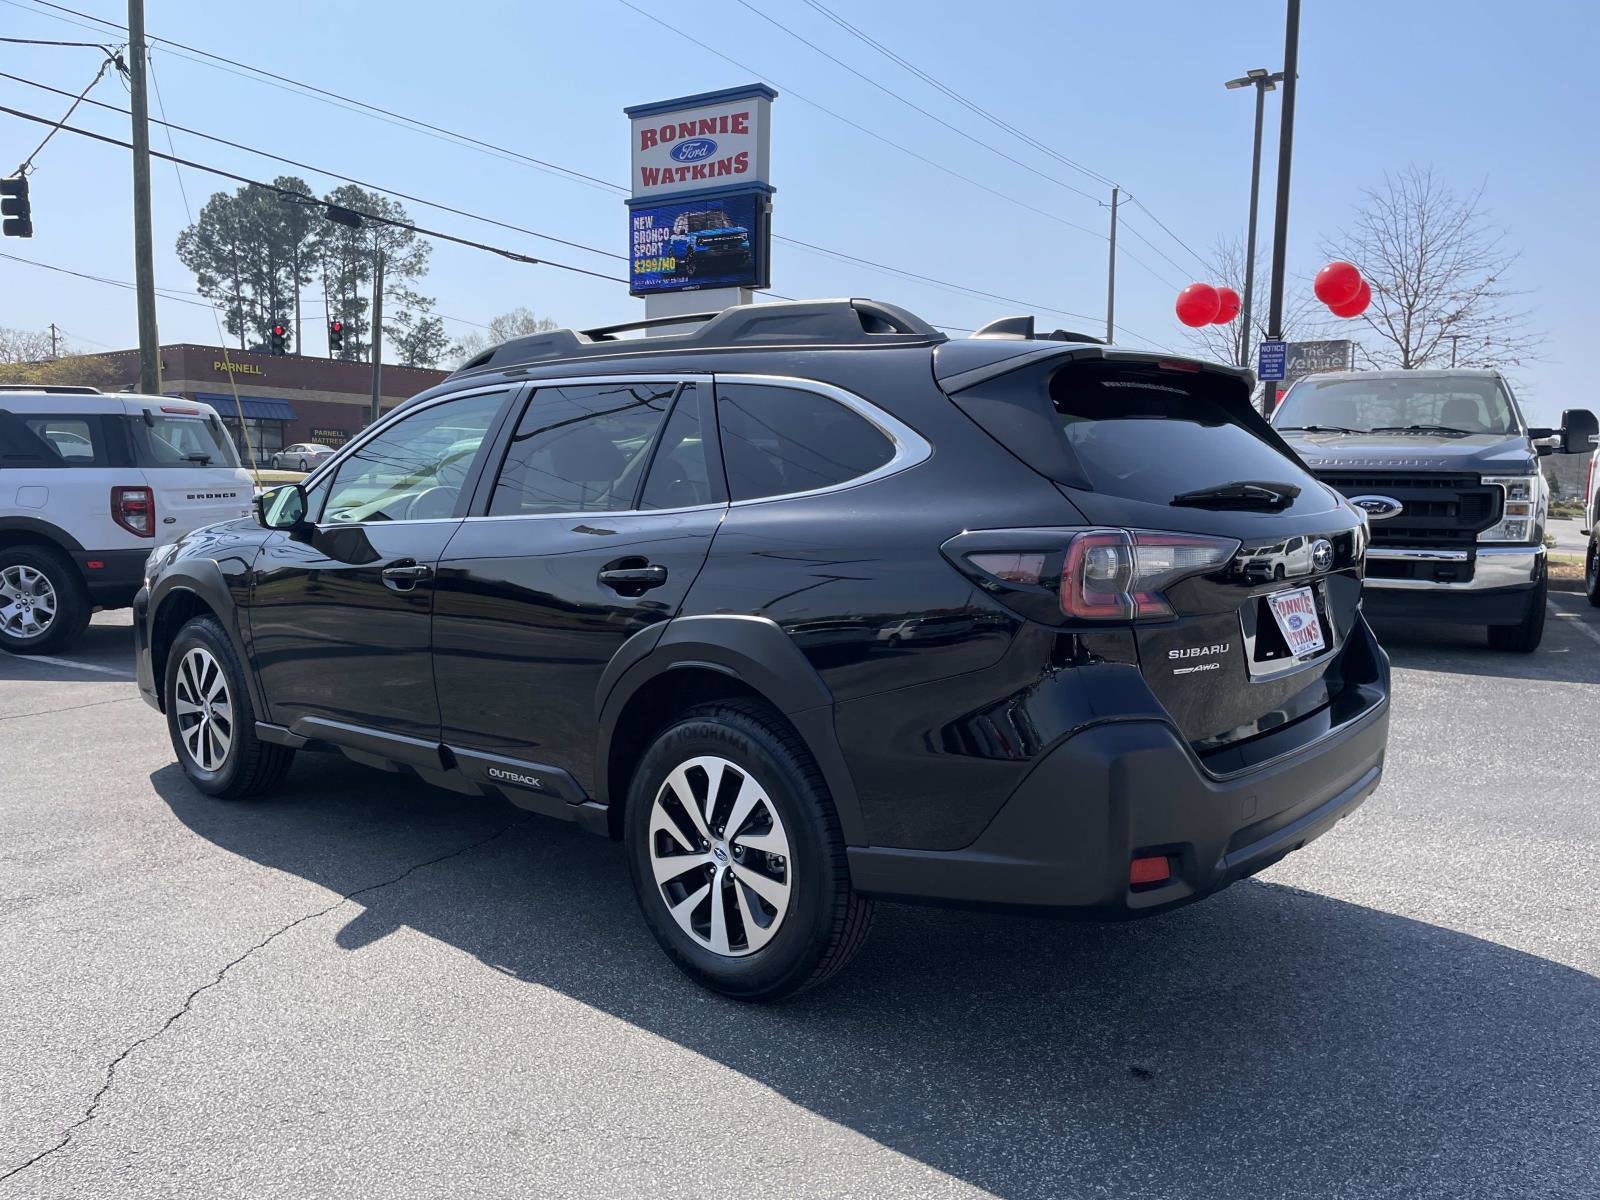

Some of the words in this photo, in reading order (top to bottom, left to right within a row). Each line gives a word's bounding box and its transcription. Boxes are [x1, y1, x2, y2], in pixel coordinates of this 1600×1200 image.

[640, 111, 750, 152] RONNIE
[679, 142, 708, 160] Ford
[640, 151, 749, 187] WATKINS
[633, 215, 653, 231] NEW
[633, 227, 670, 244] BRONCO
[633, 242, 664, 257] SPORT
[1261, 345, 1284, 353] NOTICE
[1301, 347, 1324, 357] The
[213, 360, 263, 375] PARNELL
[311, 437, 347, 445] MATTRESS
[314, 429, 345, 437] PARNELL
[1168, 643, 1230, 660] SUBARU
[1191, 662, 1220, 673] AWD
[675, 724, 749, 756] YOKOHAMA
[488, 768, 541, 787] OUTBACK
